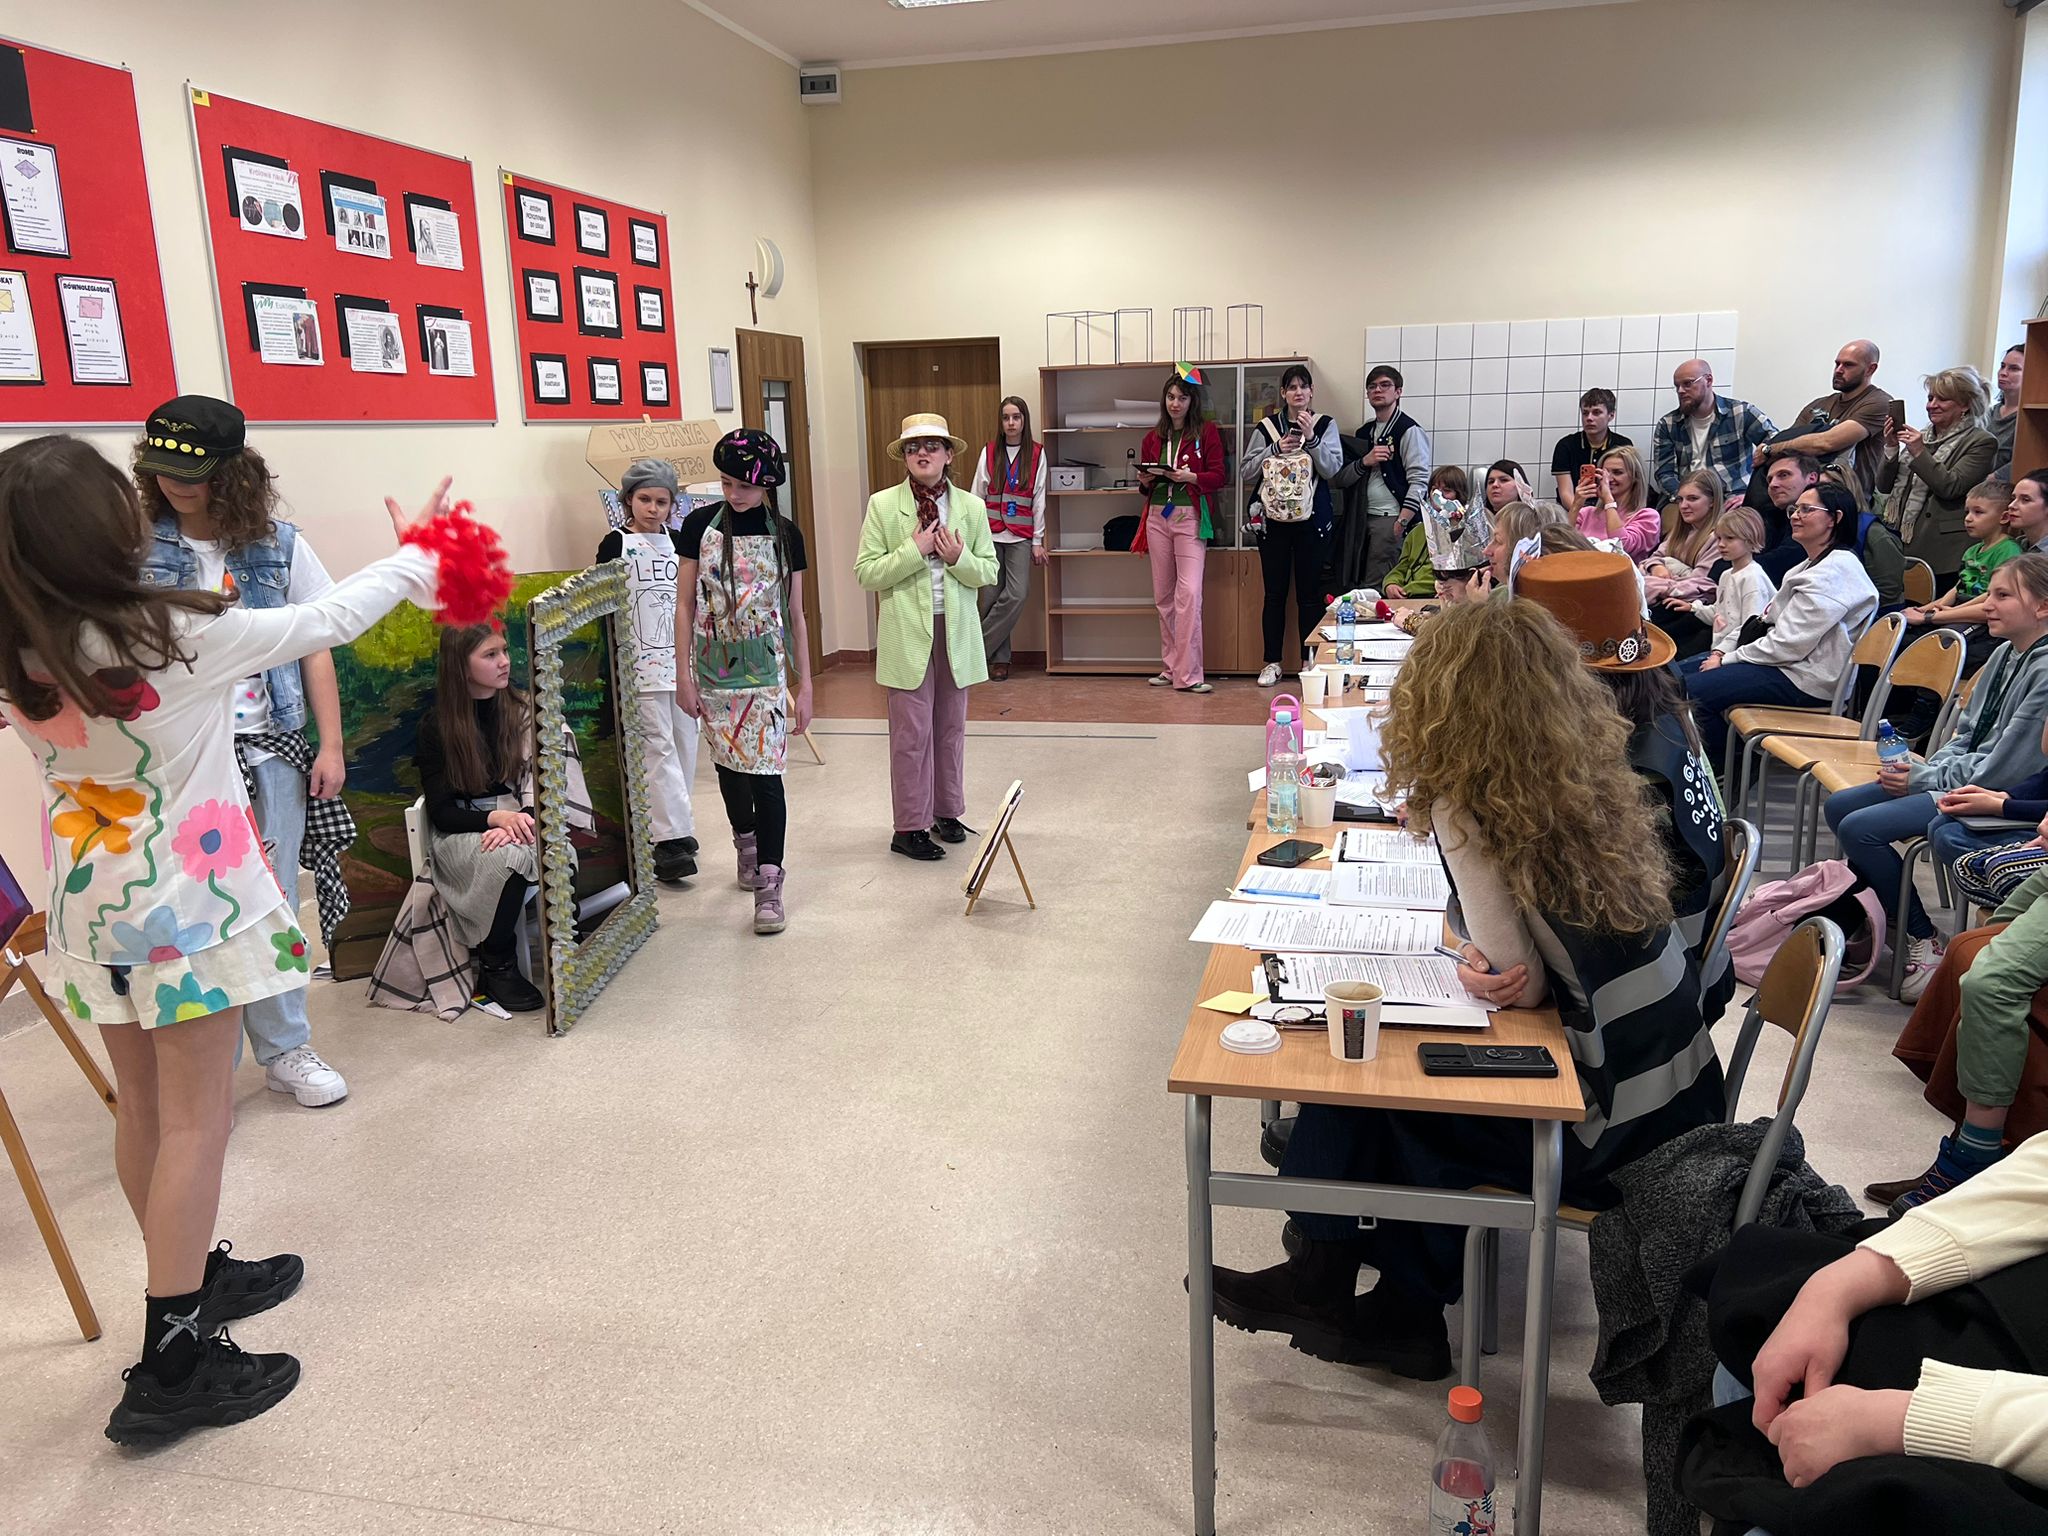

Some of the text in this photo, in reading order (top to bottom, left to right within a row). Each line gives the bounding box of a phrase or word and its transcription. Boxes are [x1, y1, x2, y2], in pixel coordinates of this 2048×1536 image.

[0, 276, 13, 285] KĄT
[609, 422, 710, 453] WYSTAWA
[634, 559, 679, 582] LEO
